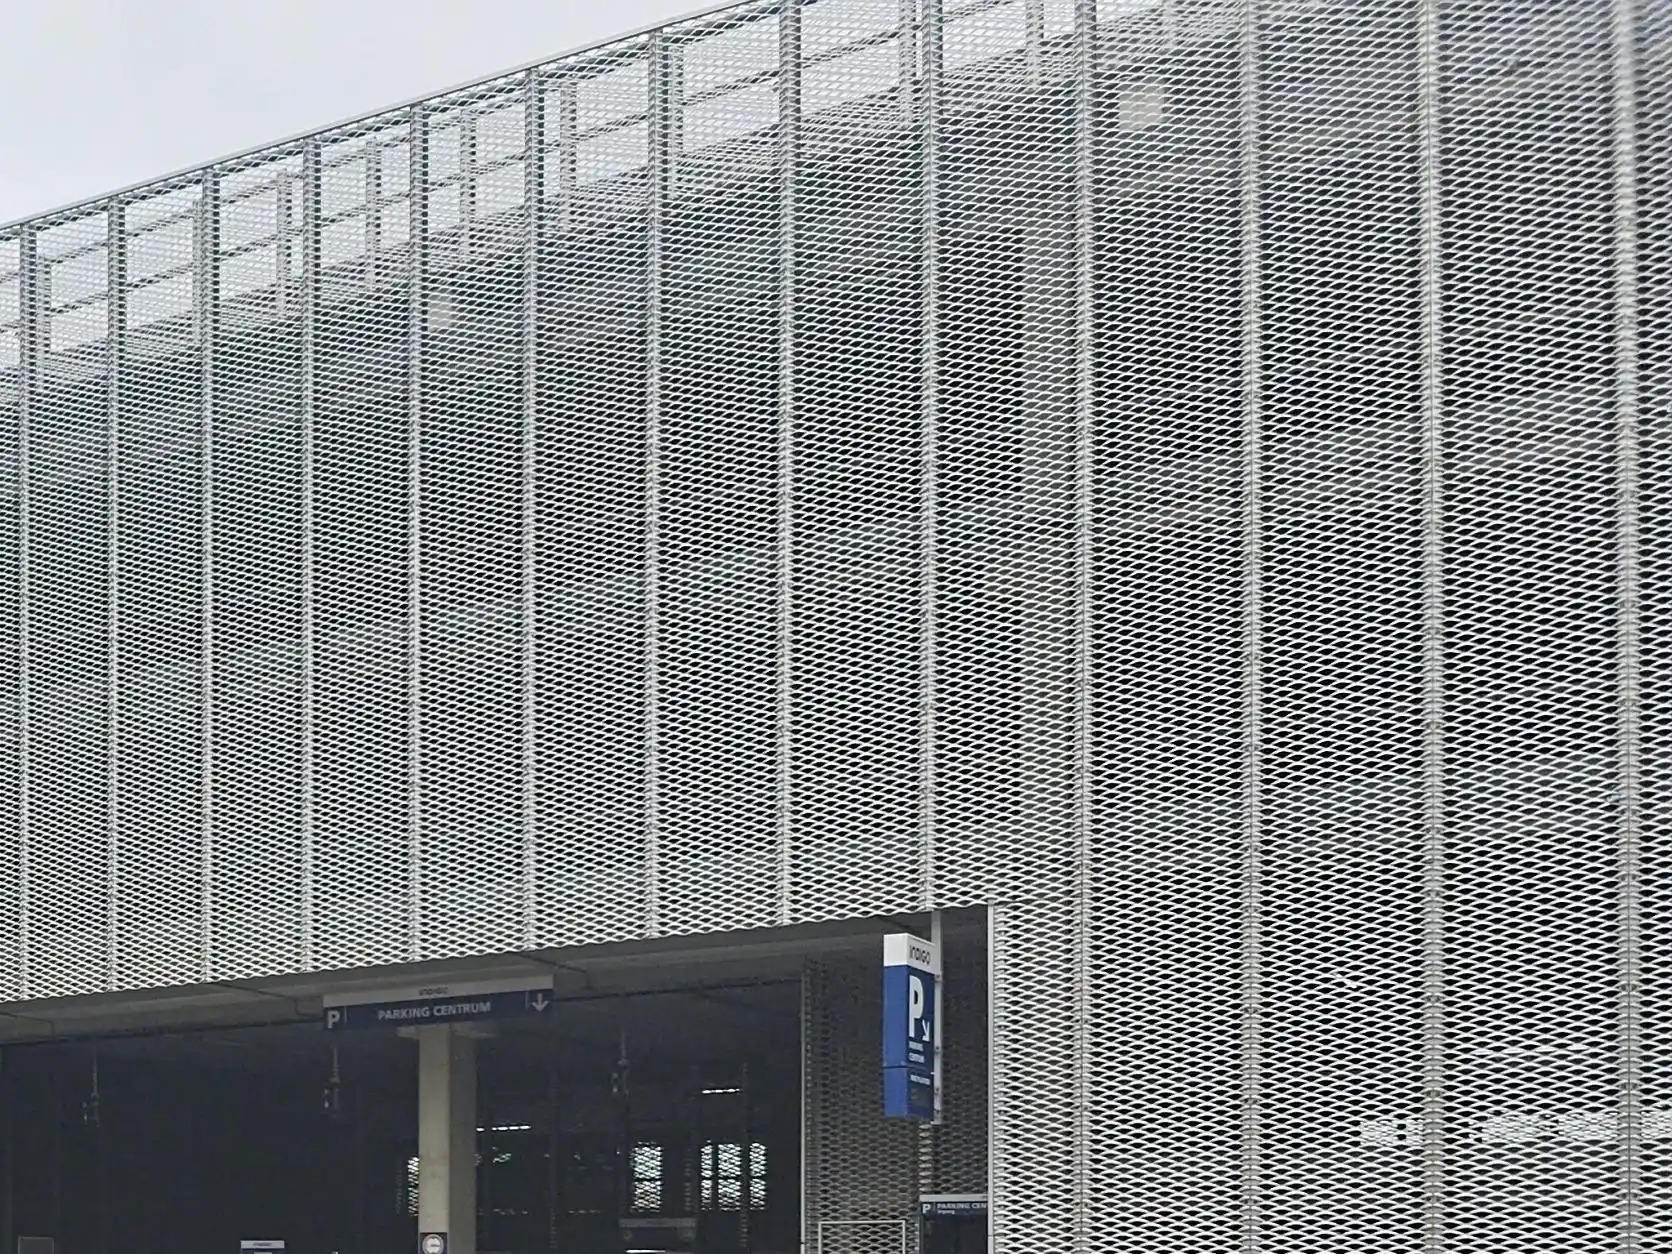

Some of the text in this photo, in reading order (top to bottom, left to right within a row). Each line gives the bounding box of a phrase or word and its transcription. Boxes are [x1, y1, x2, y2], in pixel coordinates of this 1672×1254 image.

[328, 1001, 492, 1029] P PARKING CENTRUM
[908, 974, 924, 1038] P
[922, 1203, 931, 1214] P
